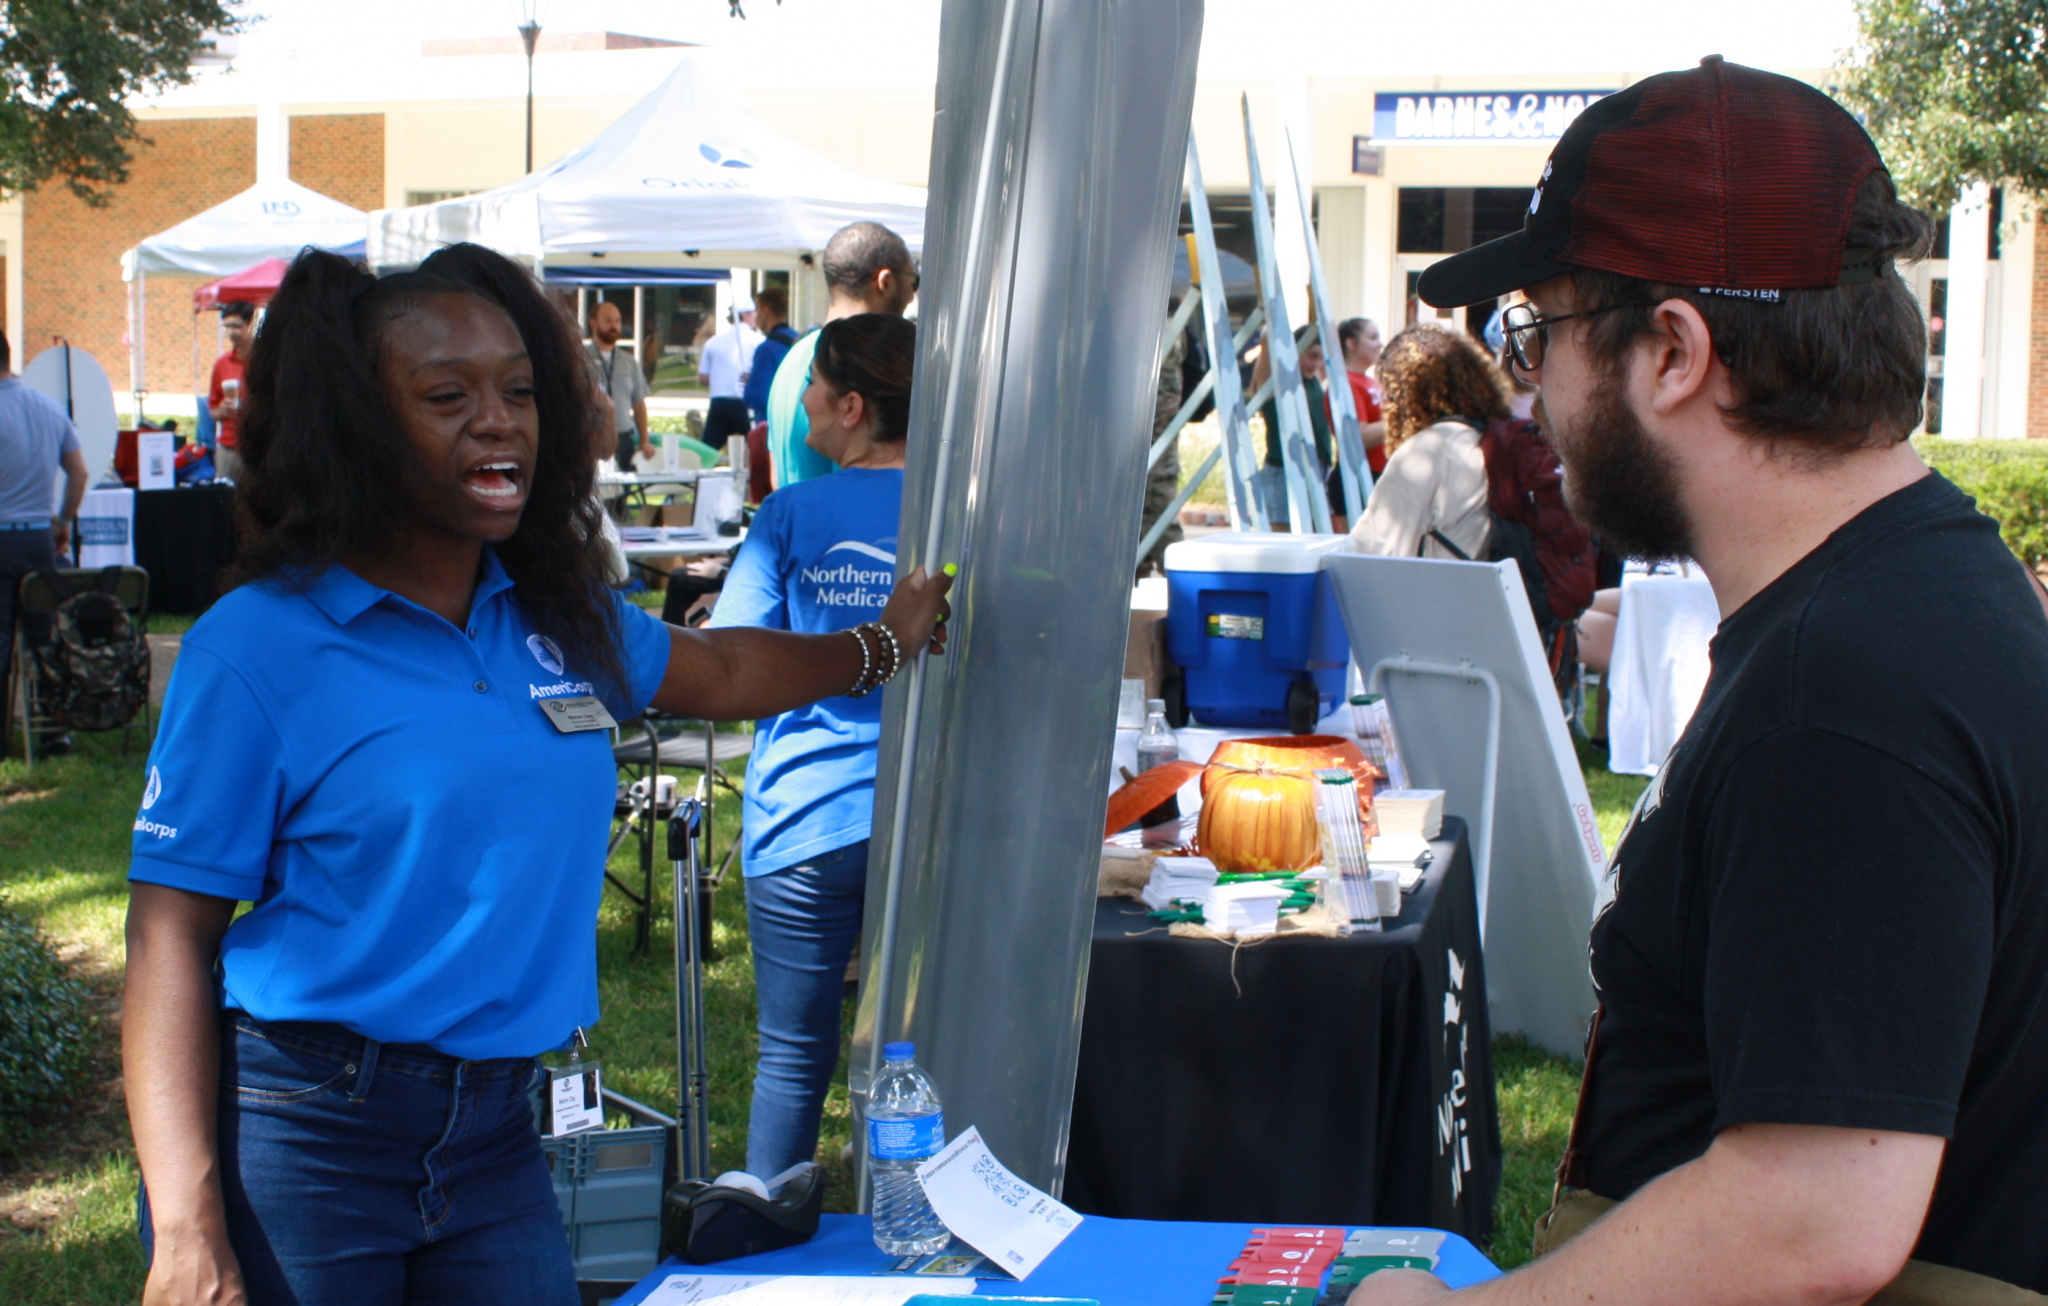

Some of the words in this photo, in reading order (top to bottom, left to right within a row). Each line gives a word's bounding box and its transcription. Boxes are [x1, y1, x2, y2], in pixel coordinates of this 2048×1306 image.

[800, 563, 892, 585] Northern
[815, 586, 893, 608] Medica
[529, 680, 595, 699] AmeriCorp
